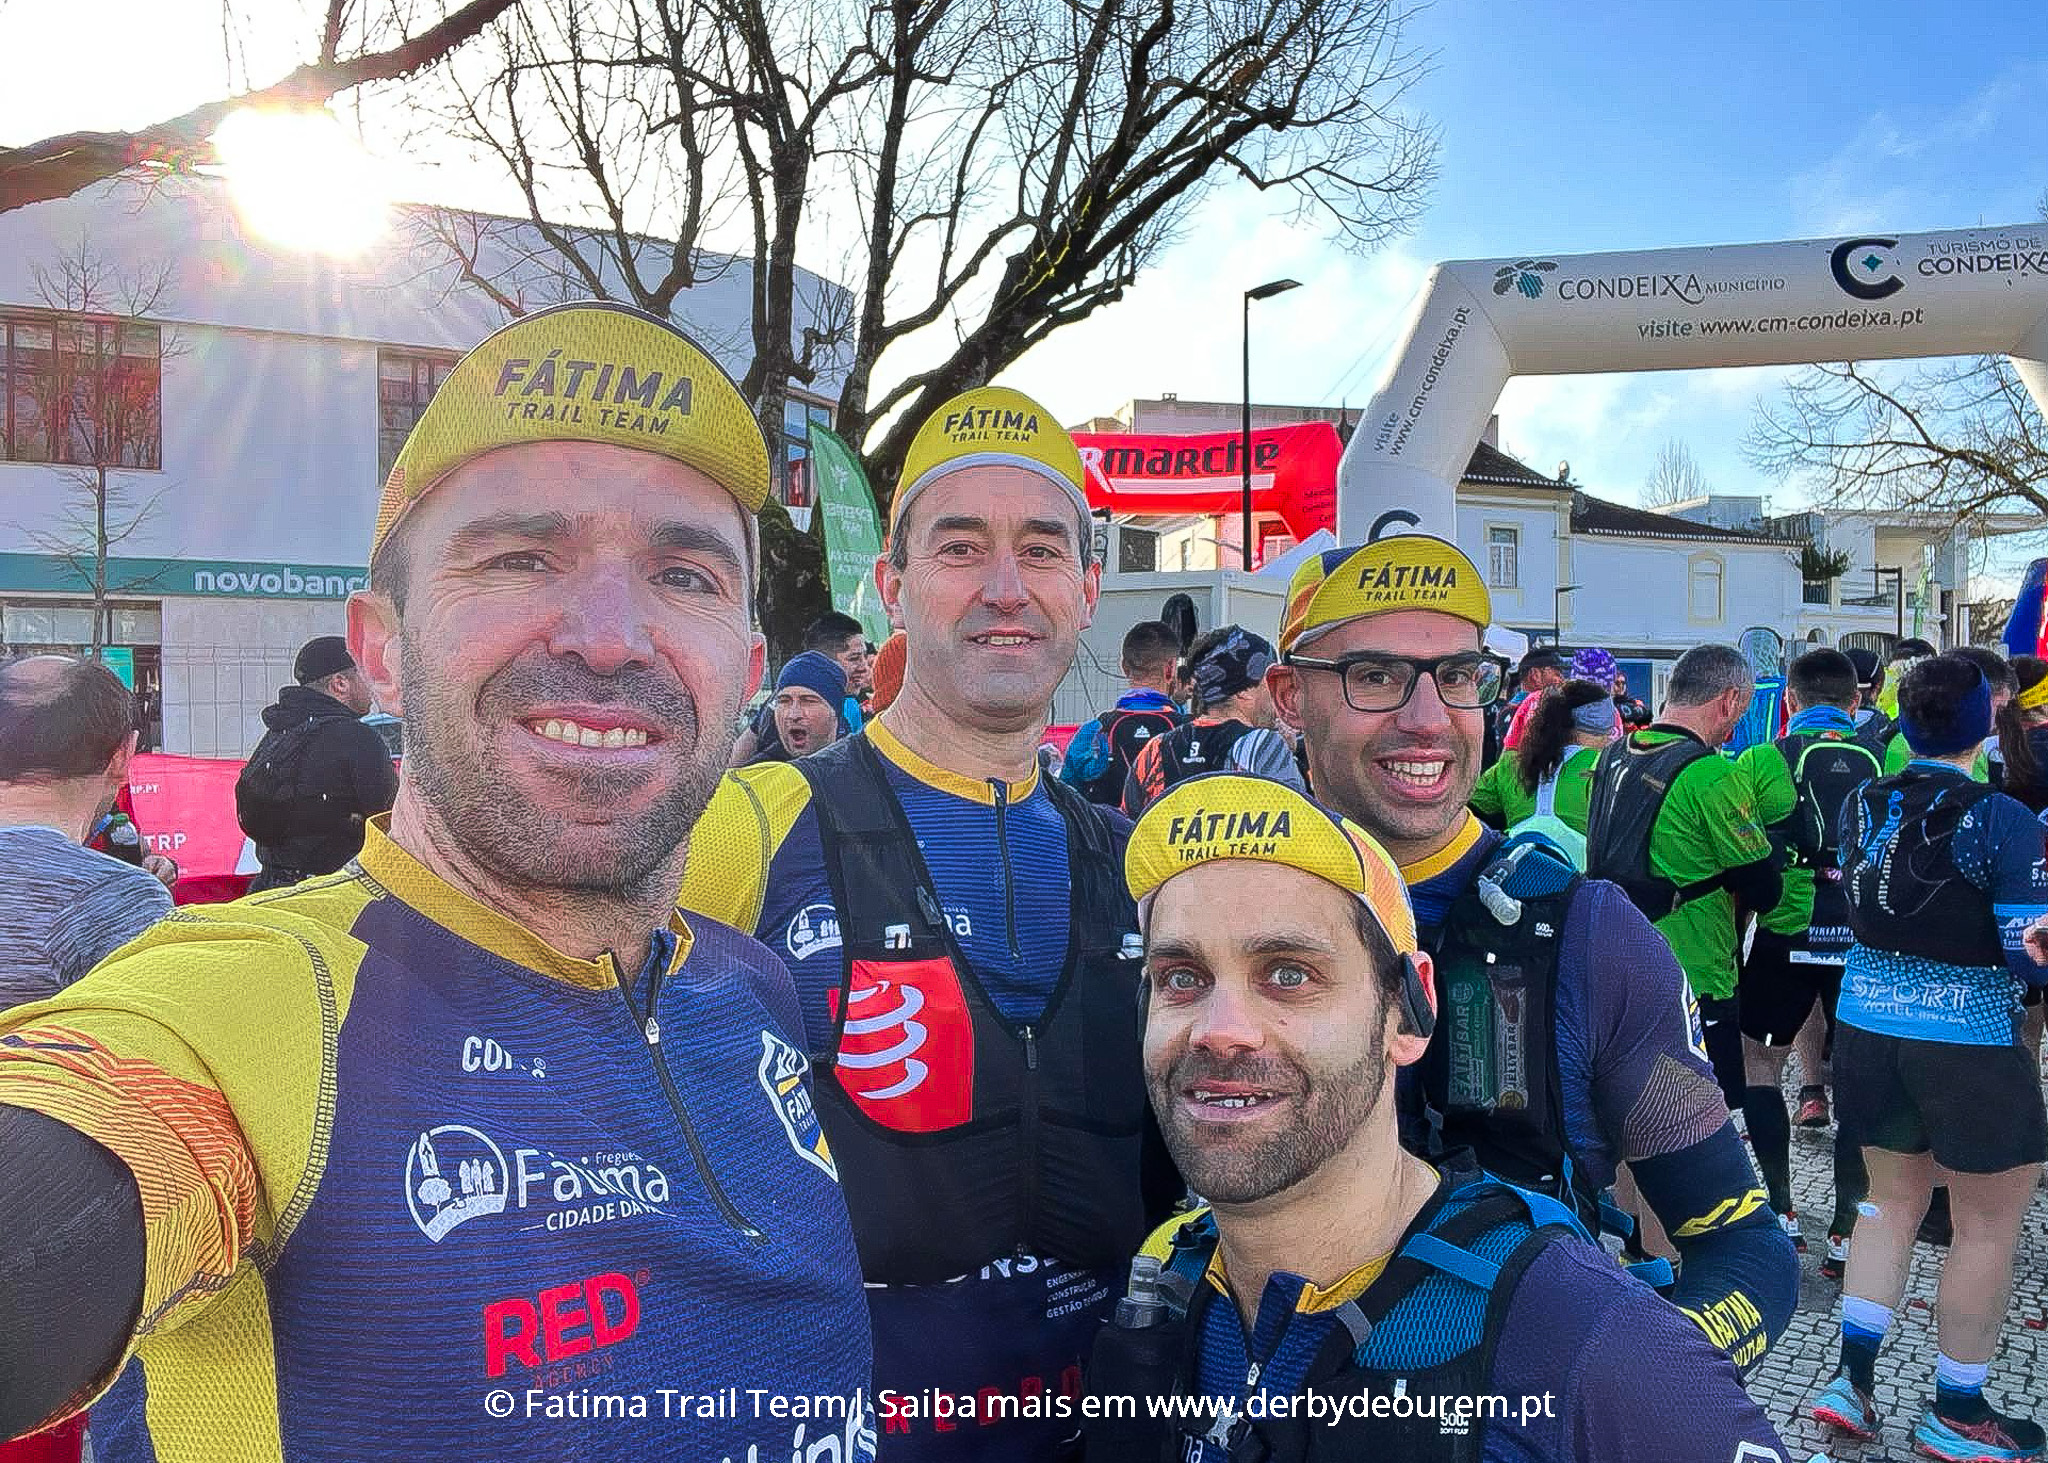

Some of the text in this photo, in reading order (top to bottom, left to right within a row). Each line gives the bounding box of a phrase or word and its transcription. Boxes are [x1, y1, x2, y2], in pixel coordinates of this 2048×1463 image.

[1926, 236, 2043, 255] TURISMO DE
[1558, 273, 1705, 304] CONDEIXA
[1637, 307, 1925, 339] visite www.cm-condeixa.pt
[493, 348, 694, 416] FÁTIMA
[1389, 306, 1471, 457] www.cm-condeixa.pt
[507, 402, 670, 435] TRAIL TEAM
[943, 405, 1039, 435] FÁTIMA
[1373, 411, 1400, 452] visite
[951, 430, 1030, 443] TRAIL TEAM
[1357, 560, 1457, 589] FÁTIMA
[1364, 588, 1448, 601] TRAIL TEAM
[1168, 808, 1292, 846] FÁTIMA
[1178, 842, 1277, 861] TRAIL TEAM
[546, 1202, 616, 1231] CIDADE
[1046, 1300, 1083, 1318] GESTÃO
[485, 1272, 640, 1379] RED
